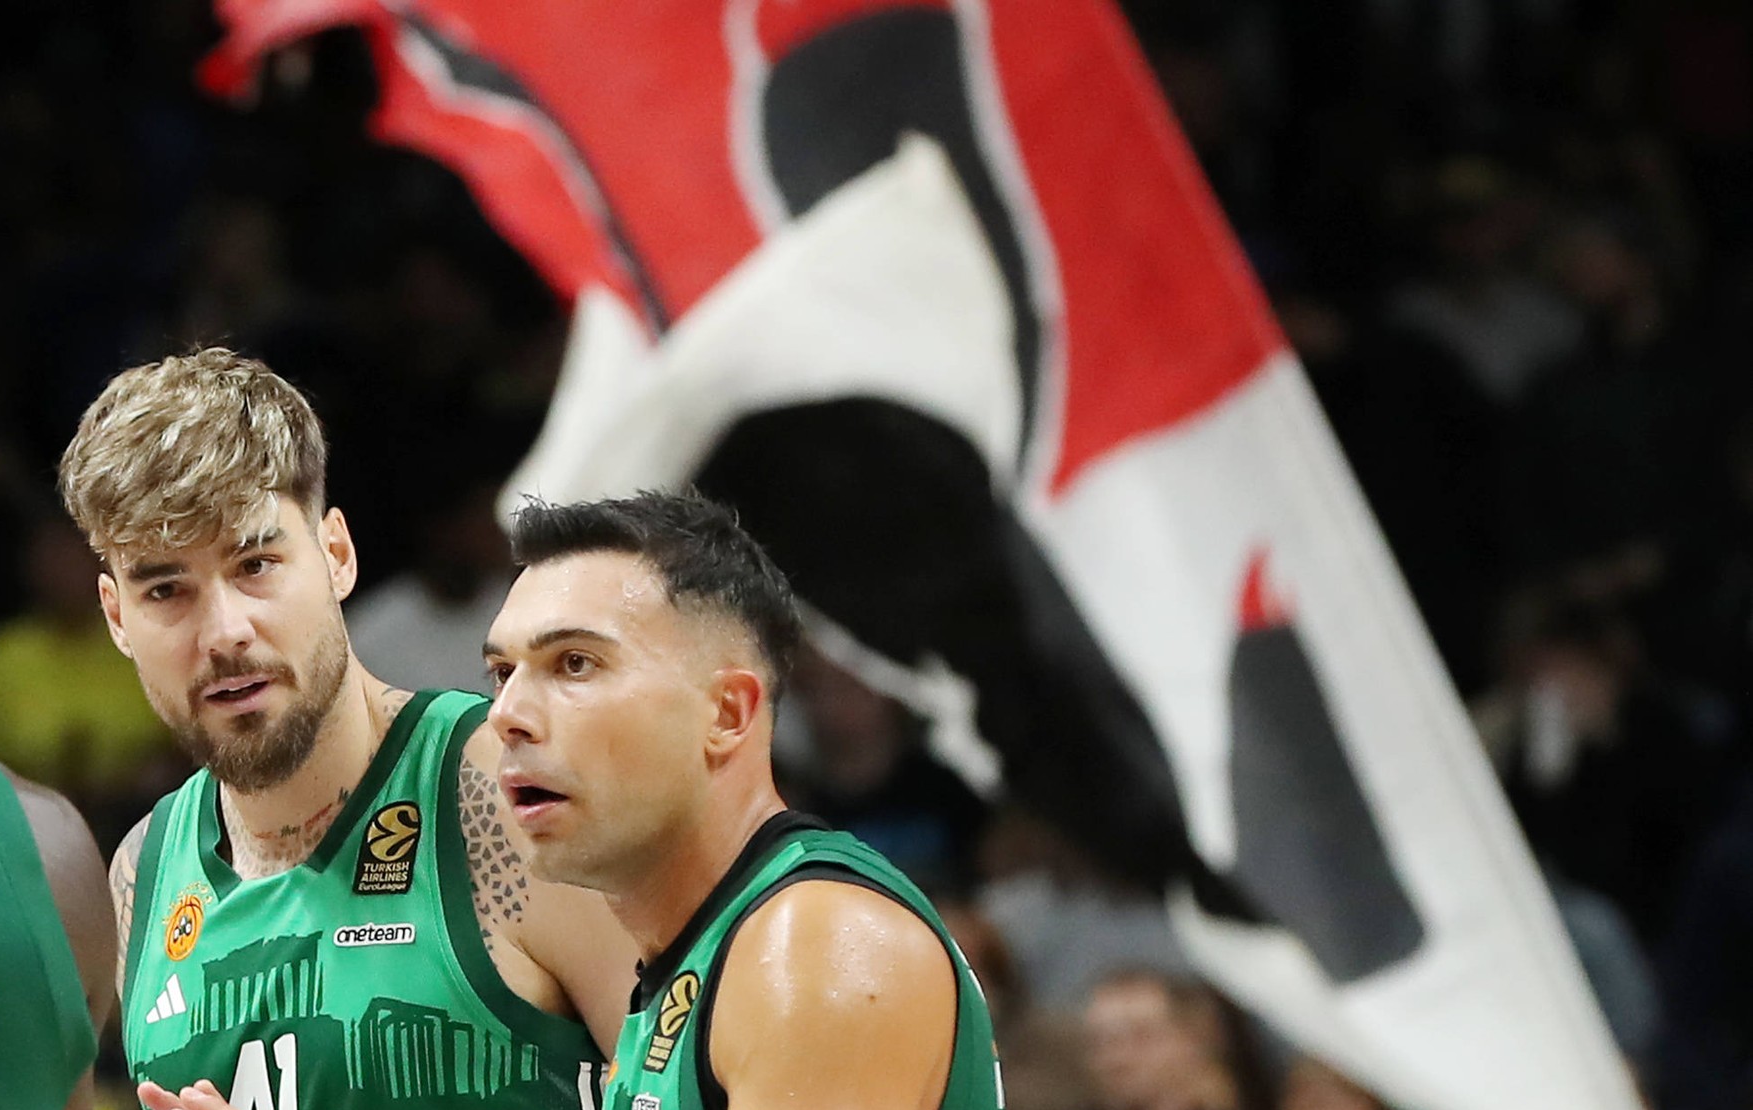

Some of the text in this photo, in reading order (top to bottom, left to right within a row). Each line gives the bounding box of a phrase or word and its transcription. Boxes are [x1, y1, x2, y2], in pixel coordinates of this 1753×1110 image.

[363, 861, 409, 872] TURKISH
[360, 871, 408, 882] AIRLINES
[337, 925, 412, 943] oneteam
